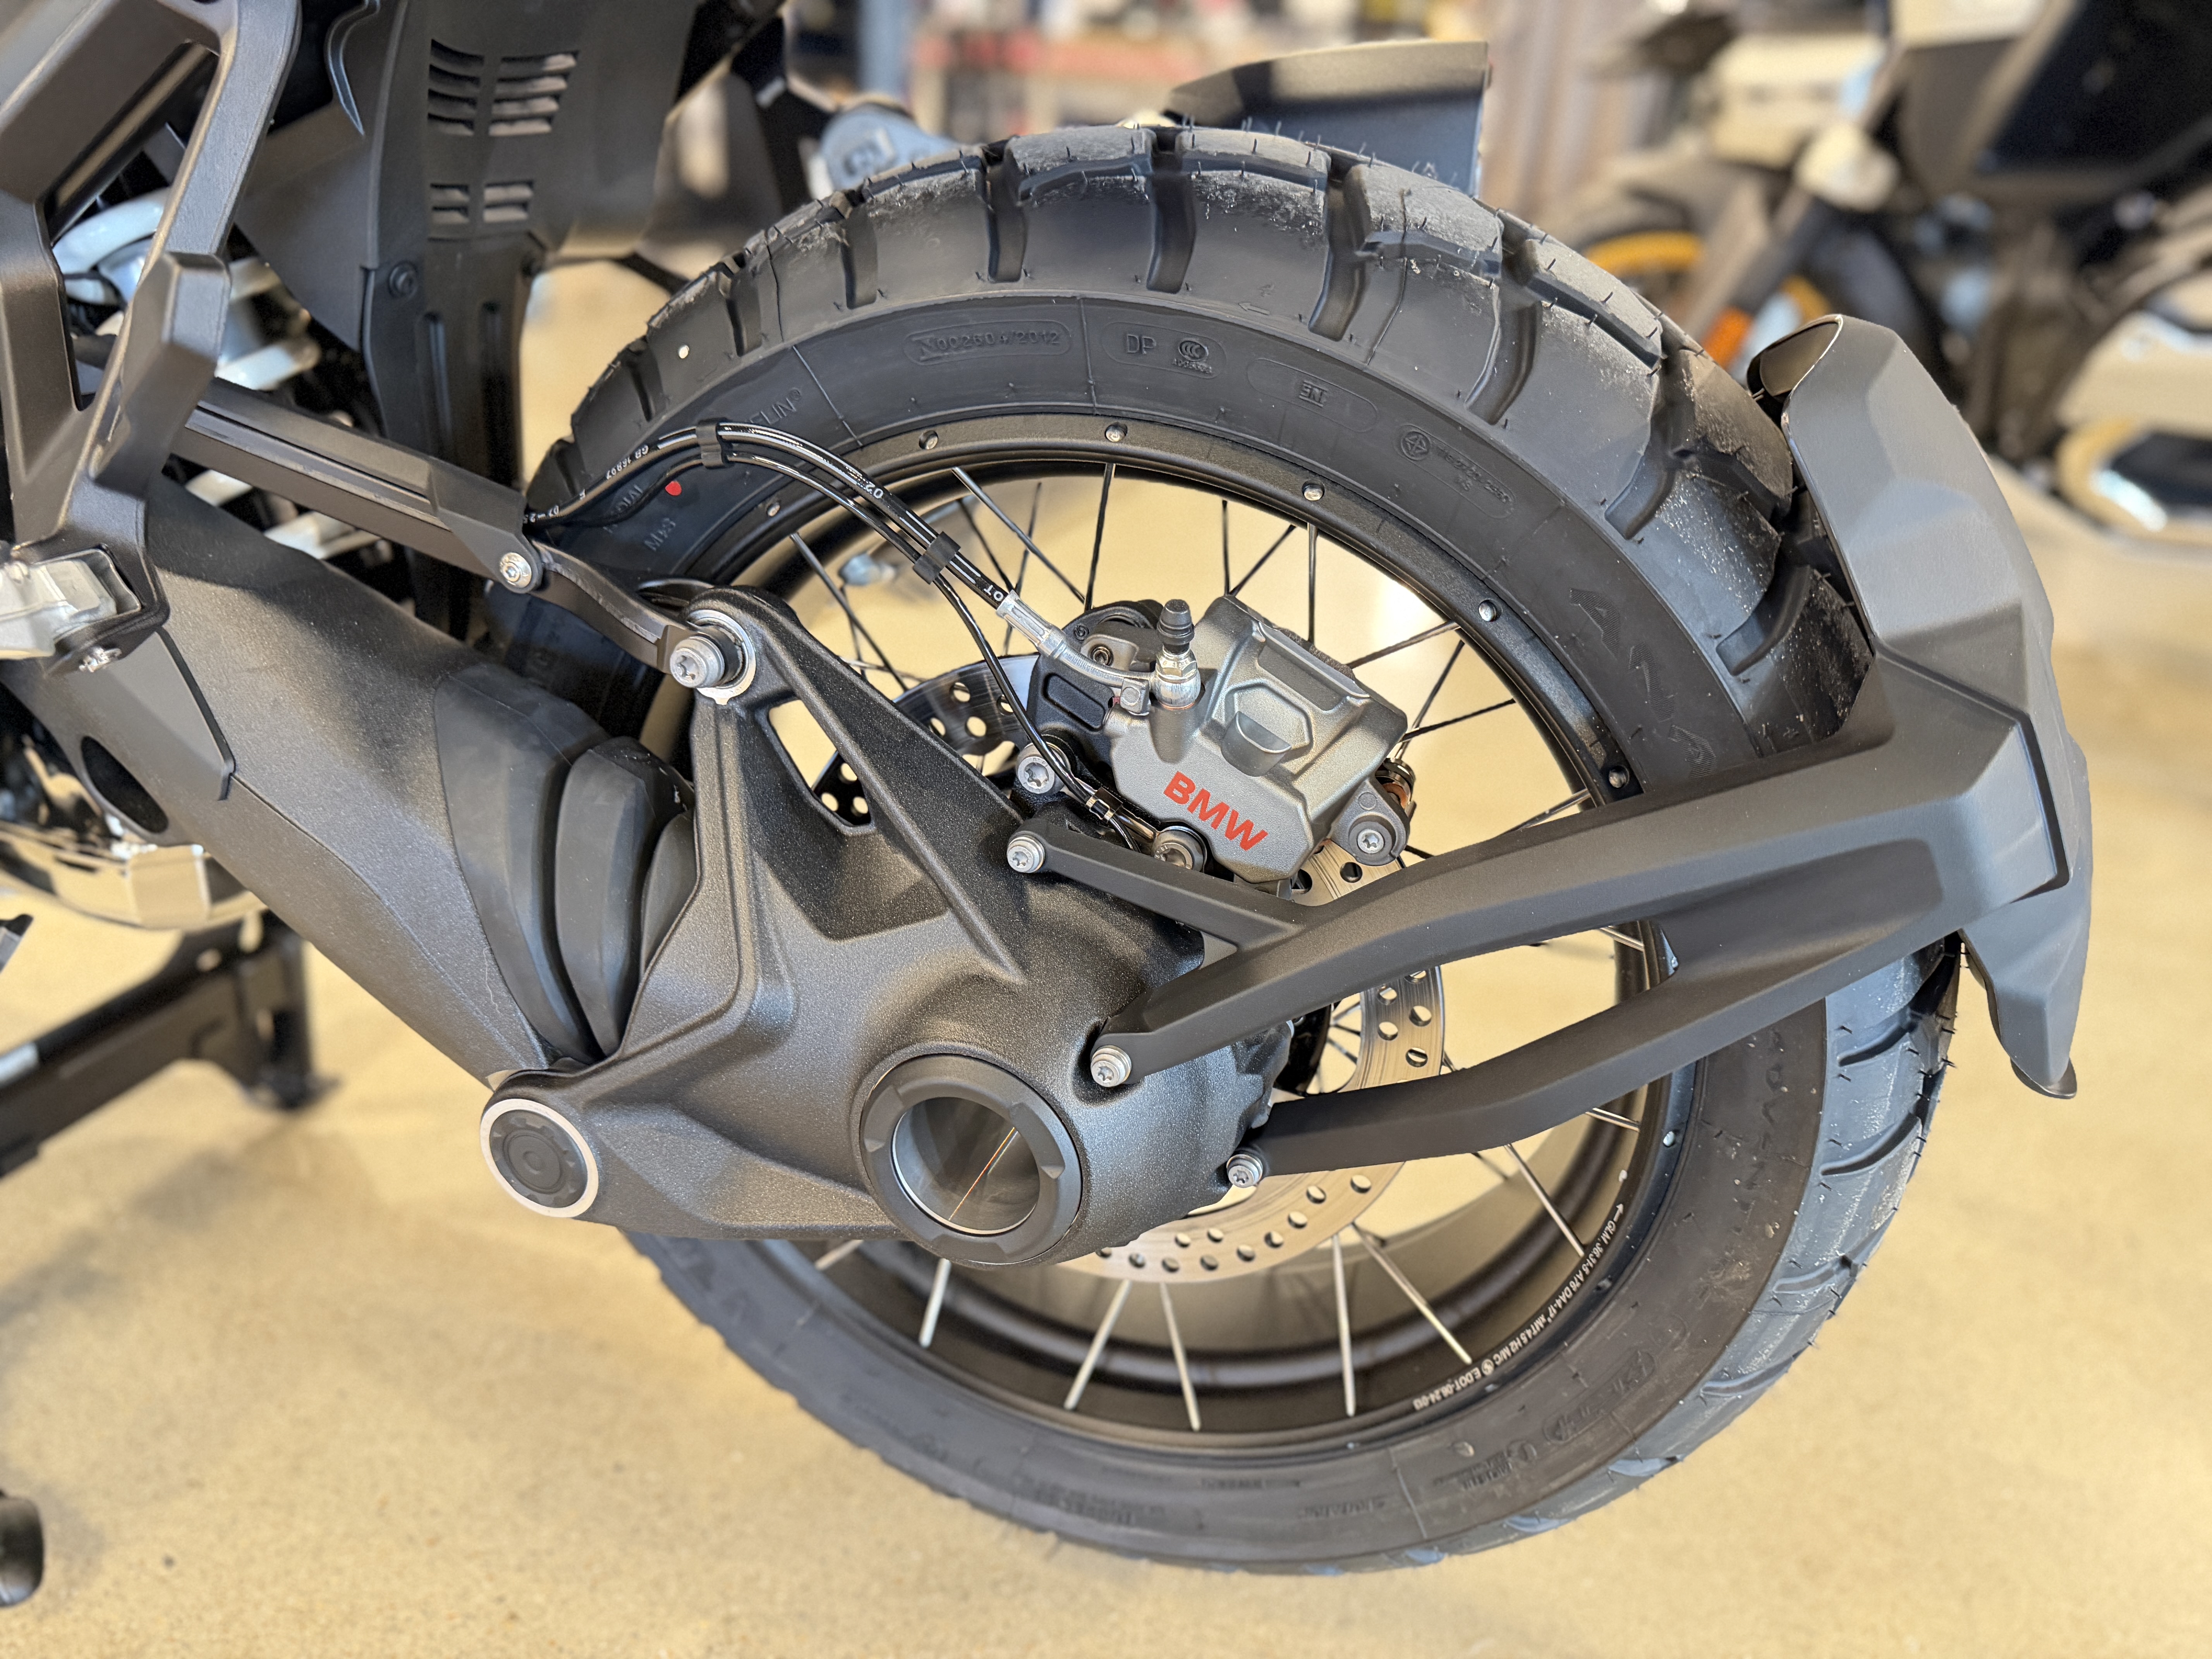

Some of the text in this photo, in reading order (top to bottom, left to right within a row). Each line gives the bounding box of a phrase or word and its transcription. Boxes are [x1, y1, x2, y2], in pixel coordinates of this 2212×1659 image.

[634, 444, 649, 460] GB
[983, 585, 1004, 603] OT
[1163, 771, 1267, 851] BMW
[1509, 1337, 1523, 1354] H2
[1493, 1346, 1512, 1366] M/C
